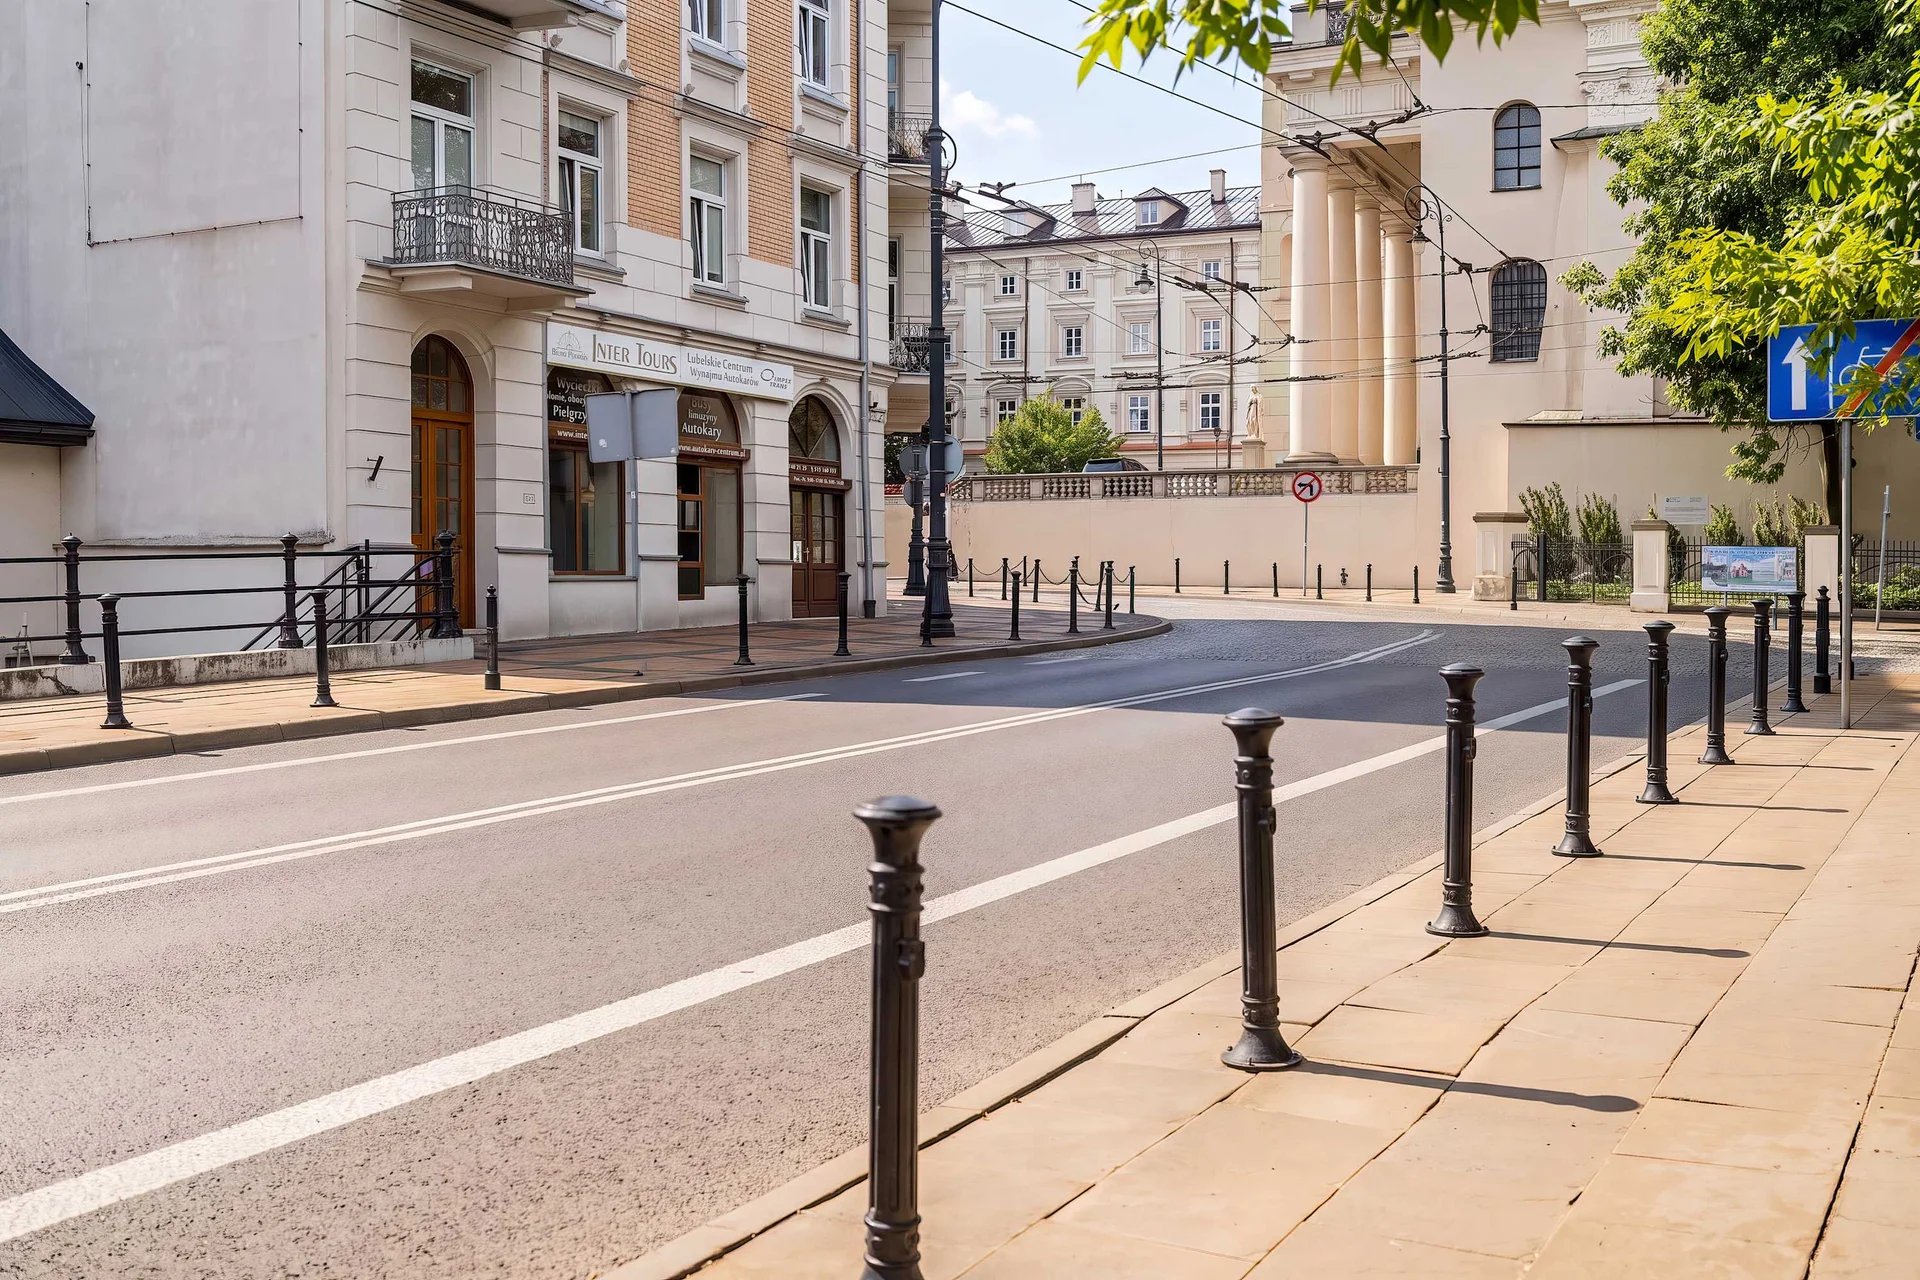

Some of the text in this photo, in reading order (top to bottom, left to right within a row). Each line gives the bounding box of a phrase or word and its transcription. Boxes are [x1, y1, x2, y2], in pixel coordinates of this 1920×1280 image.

[687, 353, 753, 374] Lubelskie Centrum
[690, 367, 760, 386] Wynajmu Autokarów
[688, 409, 718, 425] limuzyny
[682, 422, 722, 442] Autokary
